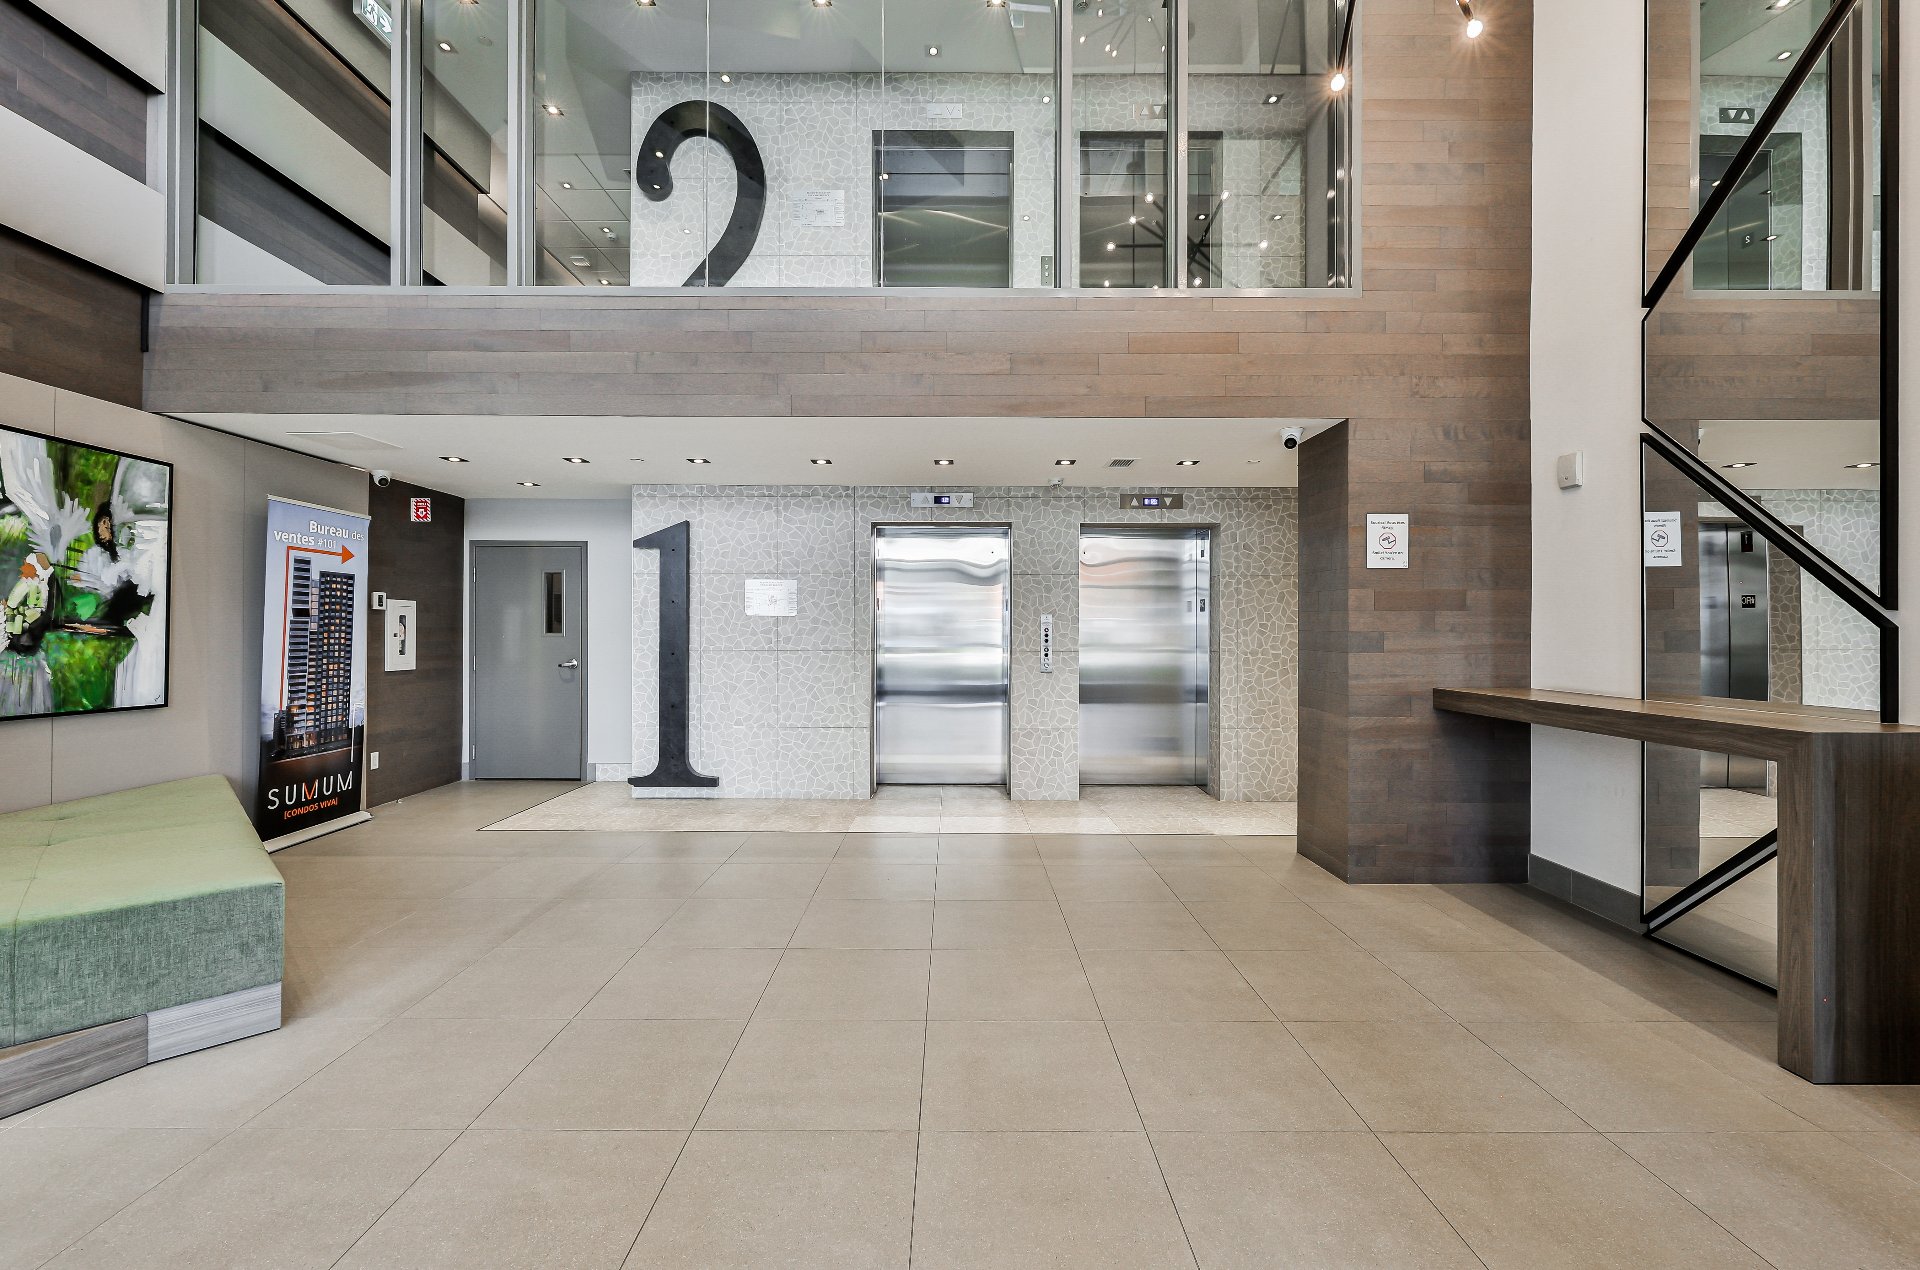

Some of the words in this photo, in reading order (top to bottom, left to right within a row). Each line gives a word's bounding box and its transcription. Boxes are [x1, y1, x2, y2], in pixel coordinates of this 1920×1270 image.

[636, 100, 766, 287] 2
[273, 531, 315, 546] ventes
[317, 538, 336, 549] #101
[309, 520, 349, 539] Bureau
[351, 530, 364, 541] des
[628, 520, 719, 787] 1
[267, 770, 353, 810] SUMUM
[284, 803, 319, 820] [CONDOS
[320, 797, 338, 809] VIVA]
